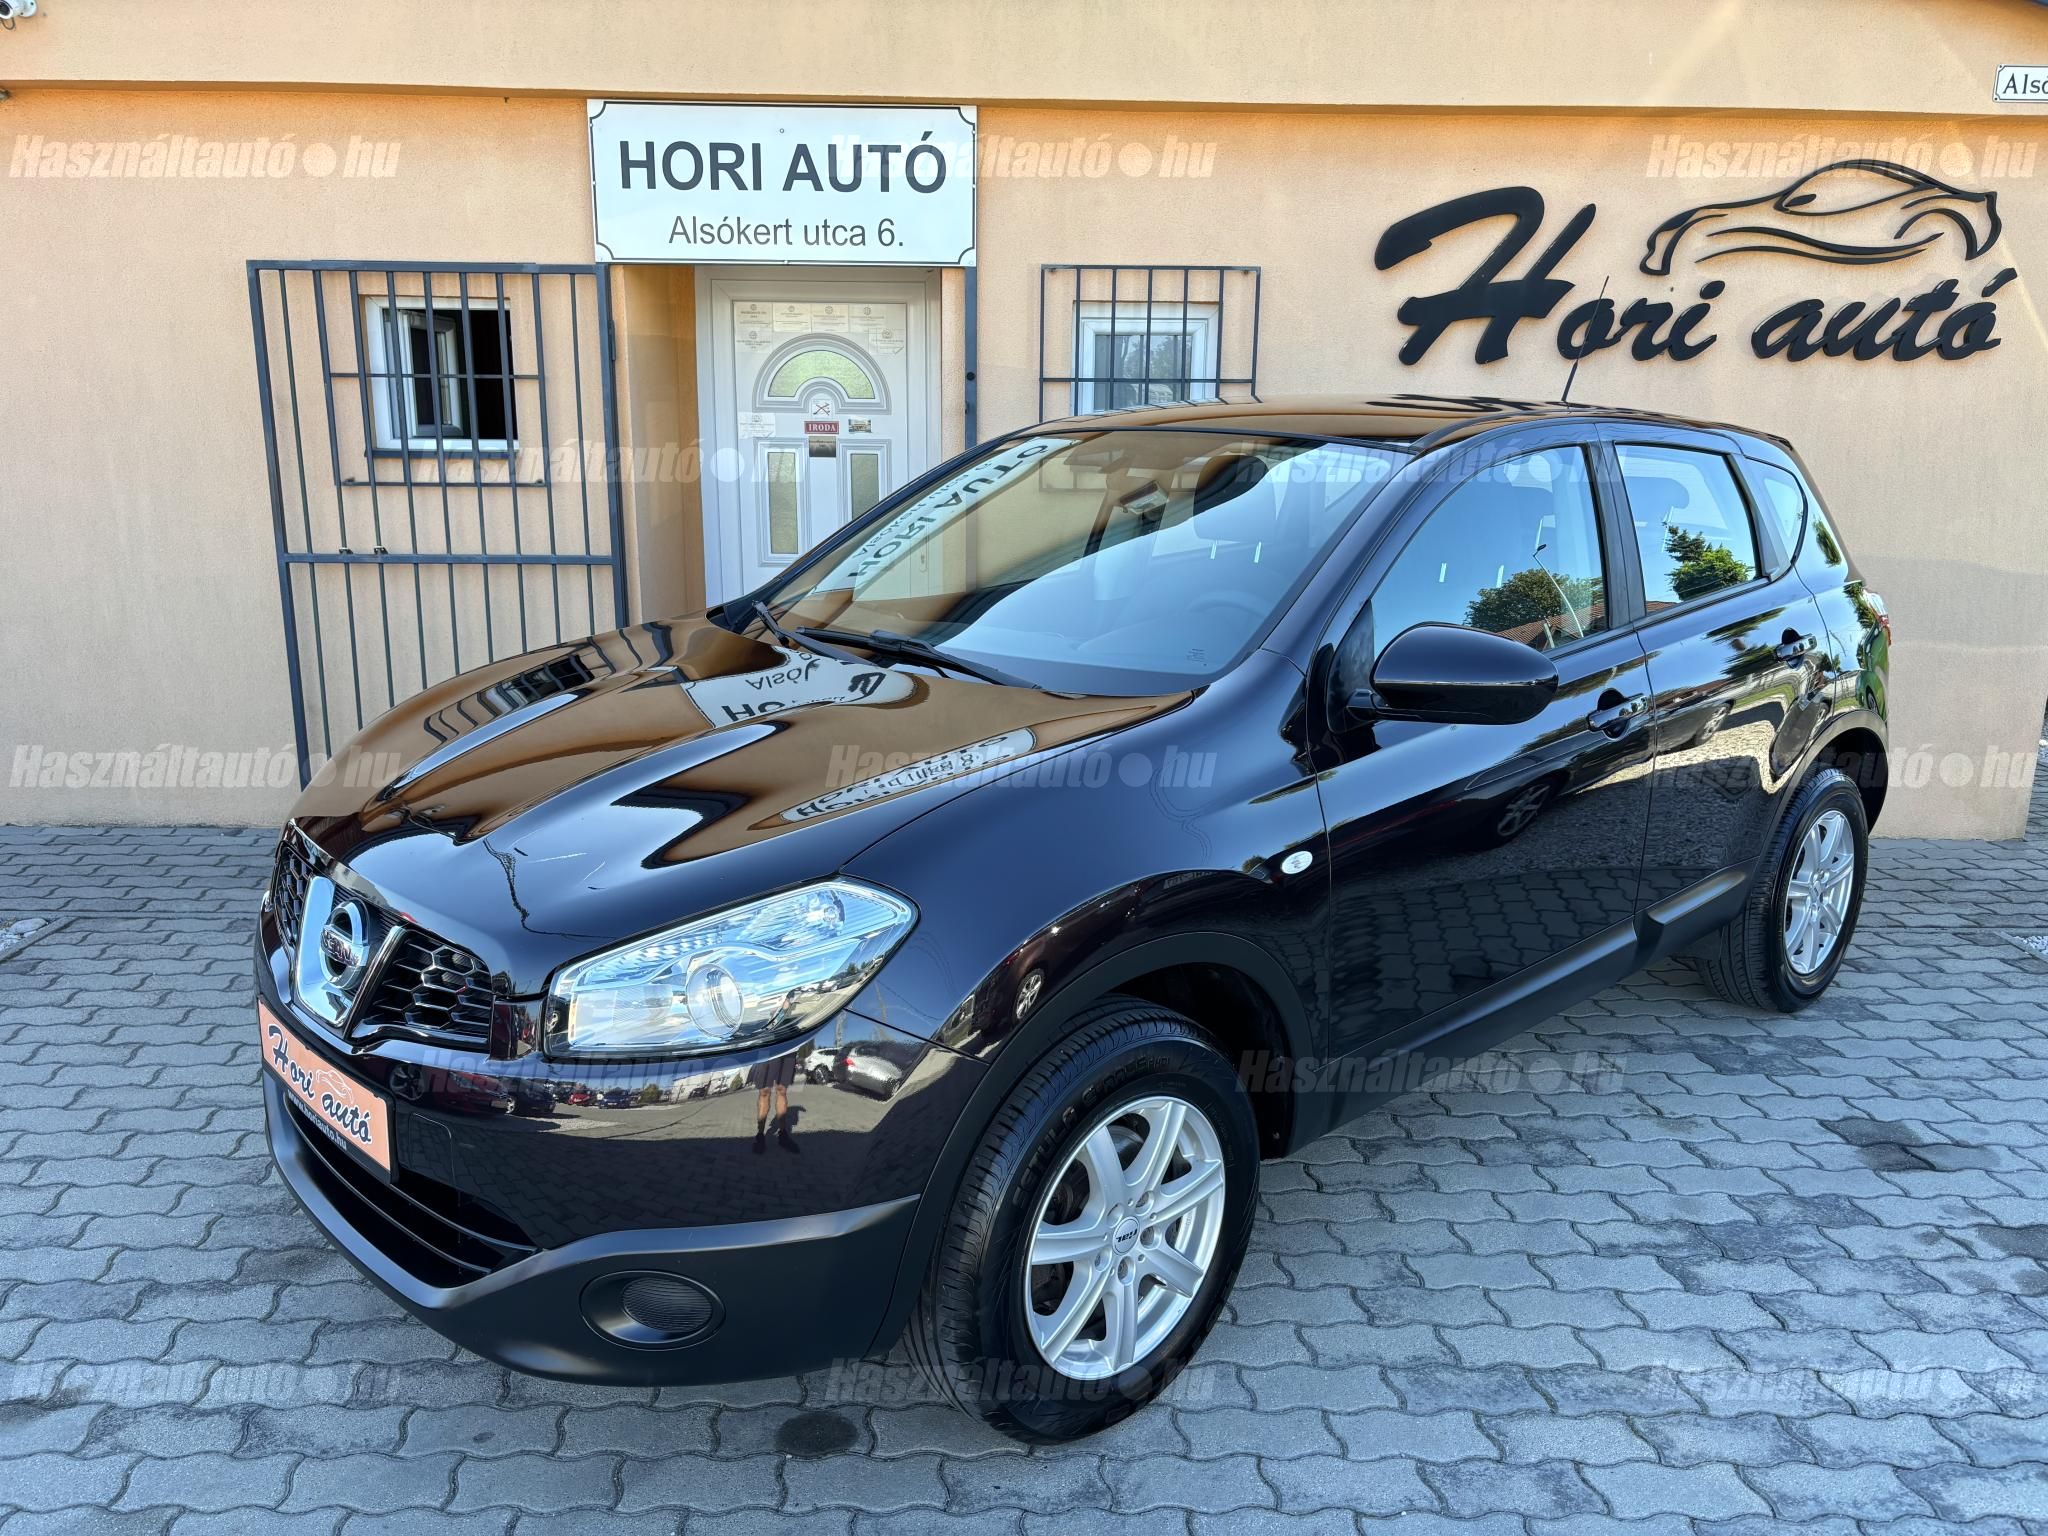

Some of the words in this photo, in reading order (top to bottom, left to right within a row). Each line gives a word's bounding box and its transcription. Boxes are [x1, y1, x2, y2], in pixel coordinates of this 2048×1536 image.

[619, 141, 762, 192] HORI
[782, 132, 947, 194] AUTÓ
[669, 215, 793, 247] Alsókert
[804, 222, 866, 247] utca
[877, 218, 905, 247] 6.
[1375, 186, 1725, 365] Hori
[1751, 268, 2018, 362] autó
[808, 423, 836, 432] IRODA
[268, 1024, 316, 1099] Hori
[322, 1091, 372, 1145] autó
